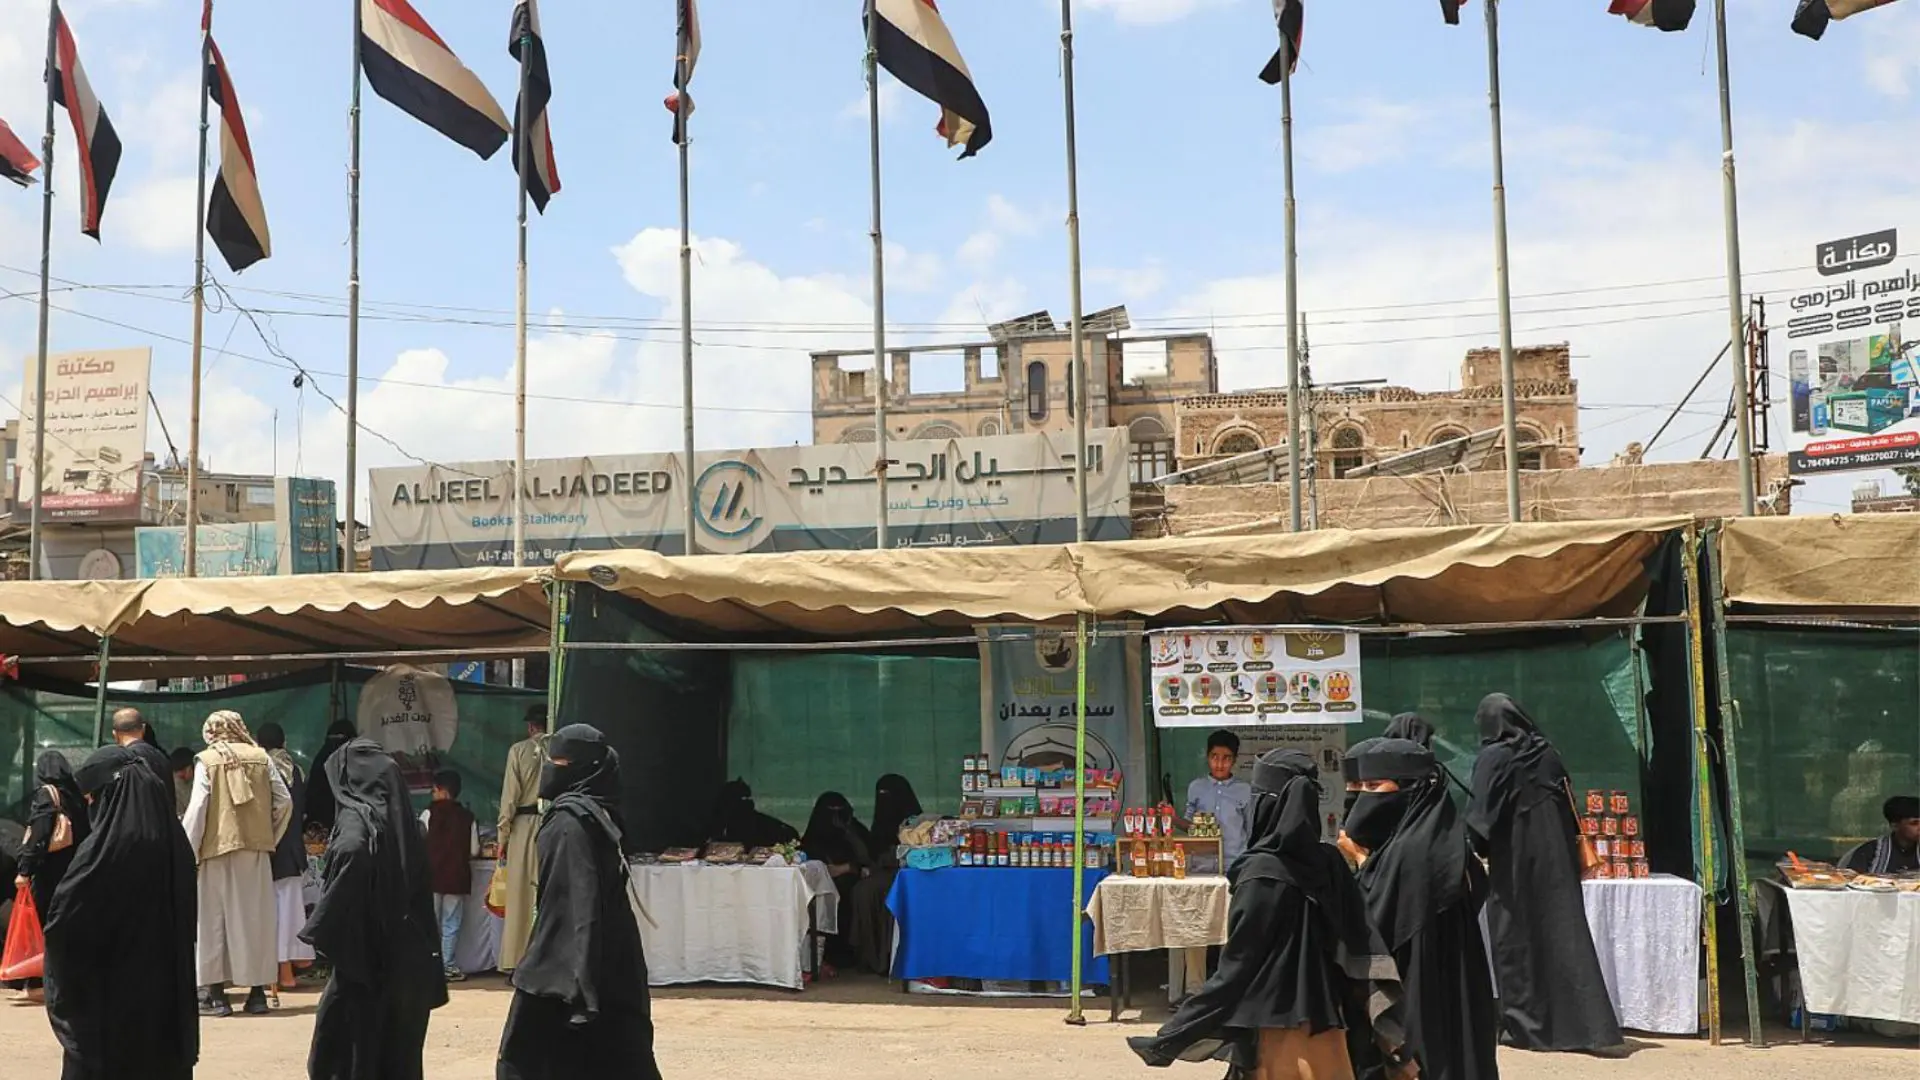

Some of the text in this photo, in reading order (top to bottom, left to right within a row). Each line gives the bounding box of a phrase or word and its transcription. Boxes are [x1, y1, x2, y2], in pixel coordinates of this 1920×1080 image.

[1823, 239, 1890, 270] مكتبة
[1790, 279, 1855, 313] الحزمي
[56, 357, 115, 379] مكتبة
[788, 453, 946, 494] الجديد
[392, 478, 499, 506] ALJEEL
[887, 494, 1009, 513] كتب وقرطاسي
[472, 511, 588, 528] Books Stationary
[953, 532, 995, 548] فرع
[1000, 701, 1052, 722] بعدان
